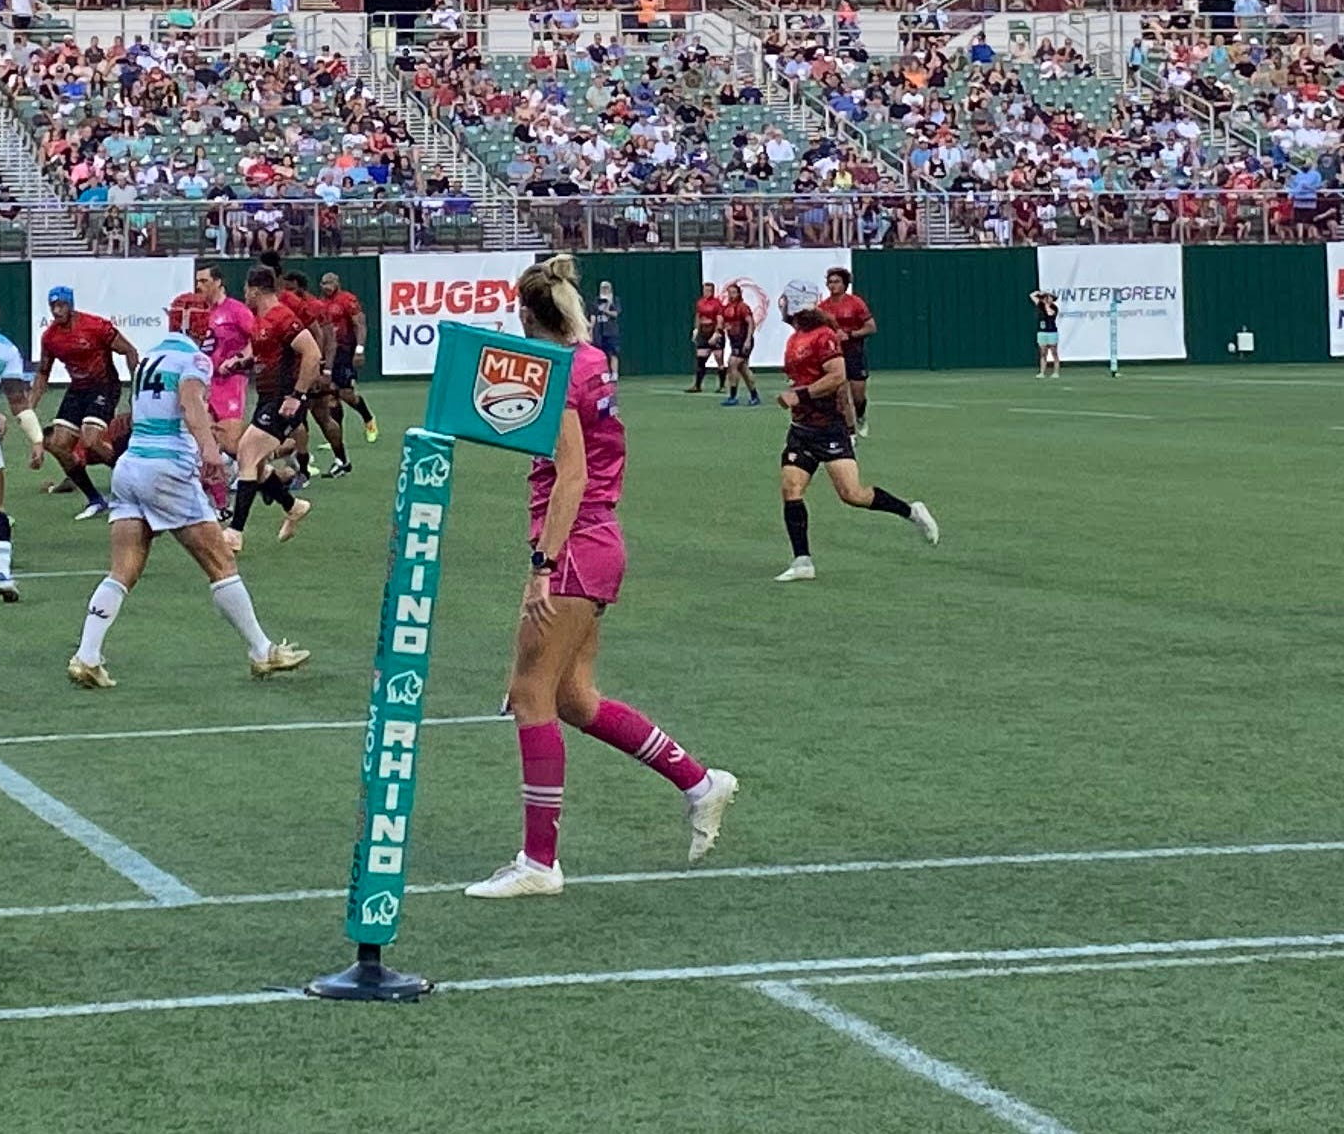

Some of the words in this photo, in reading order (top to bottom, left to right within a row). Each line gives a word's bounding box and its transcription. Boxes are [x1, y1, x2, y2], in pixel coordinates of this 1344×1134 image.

[389, 280, 518, 316] RUGBY
[389, 324, 435, 346] NO
[134, 354, 168, 401] 14
[483, 353, 544, 386] MLR
[392, 501, 444, 655] RHINO
[367, 719, 417, 875] RHINO
